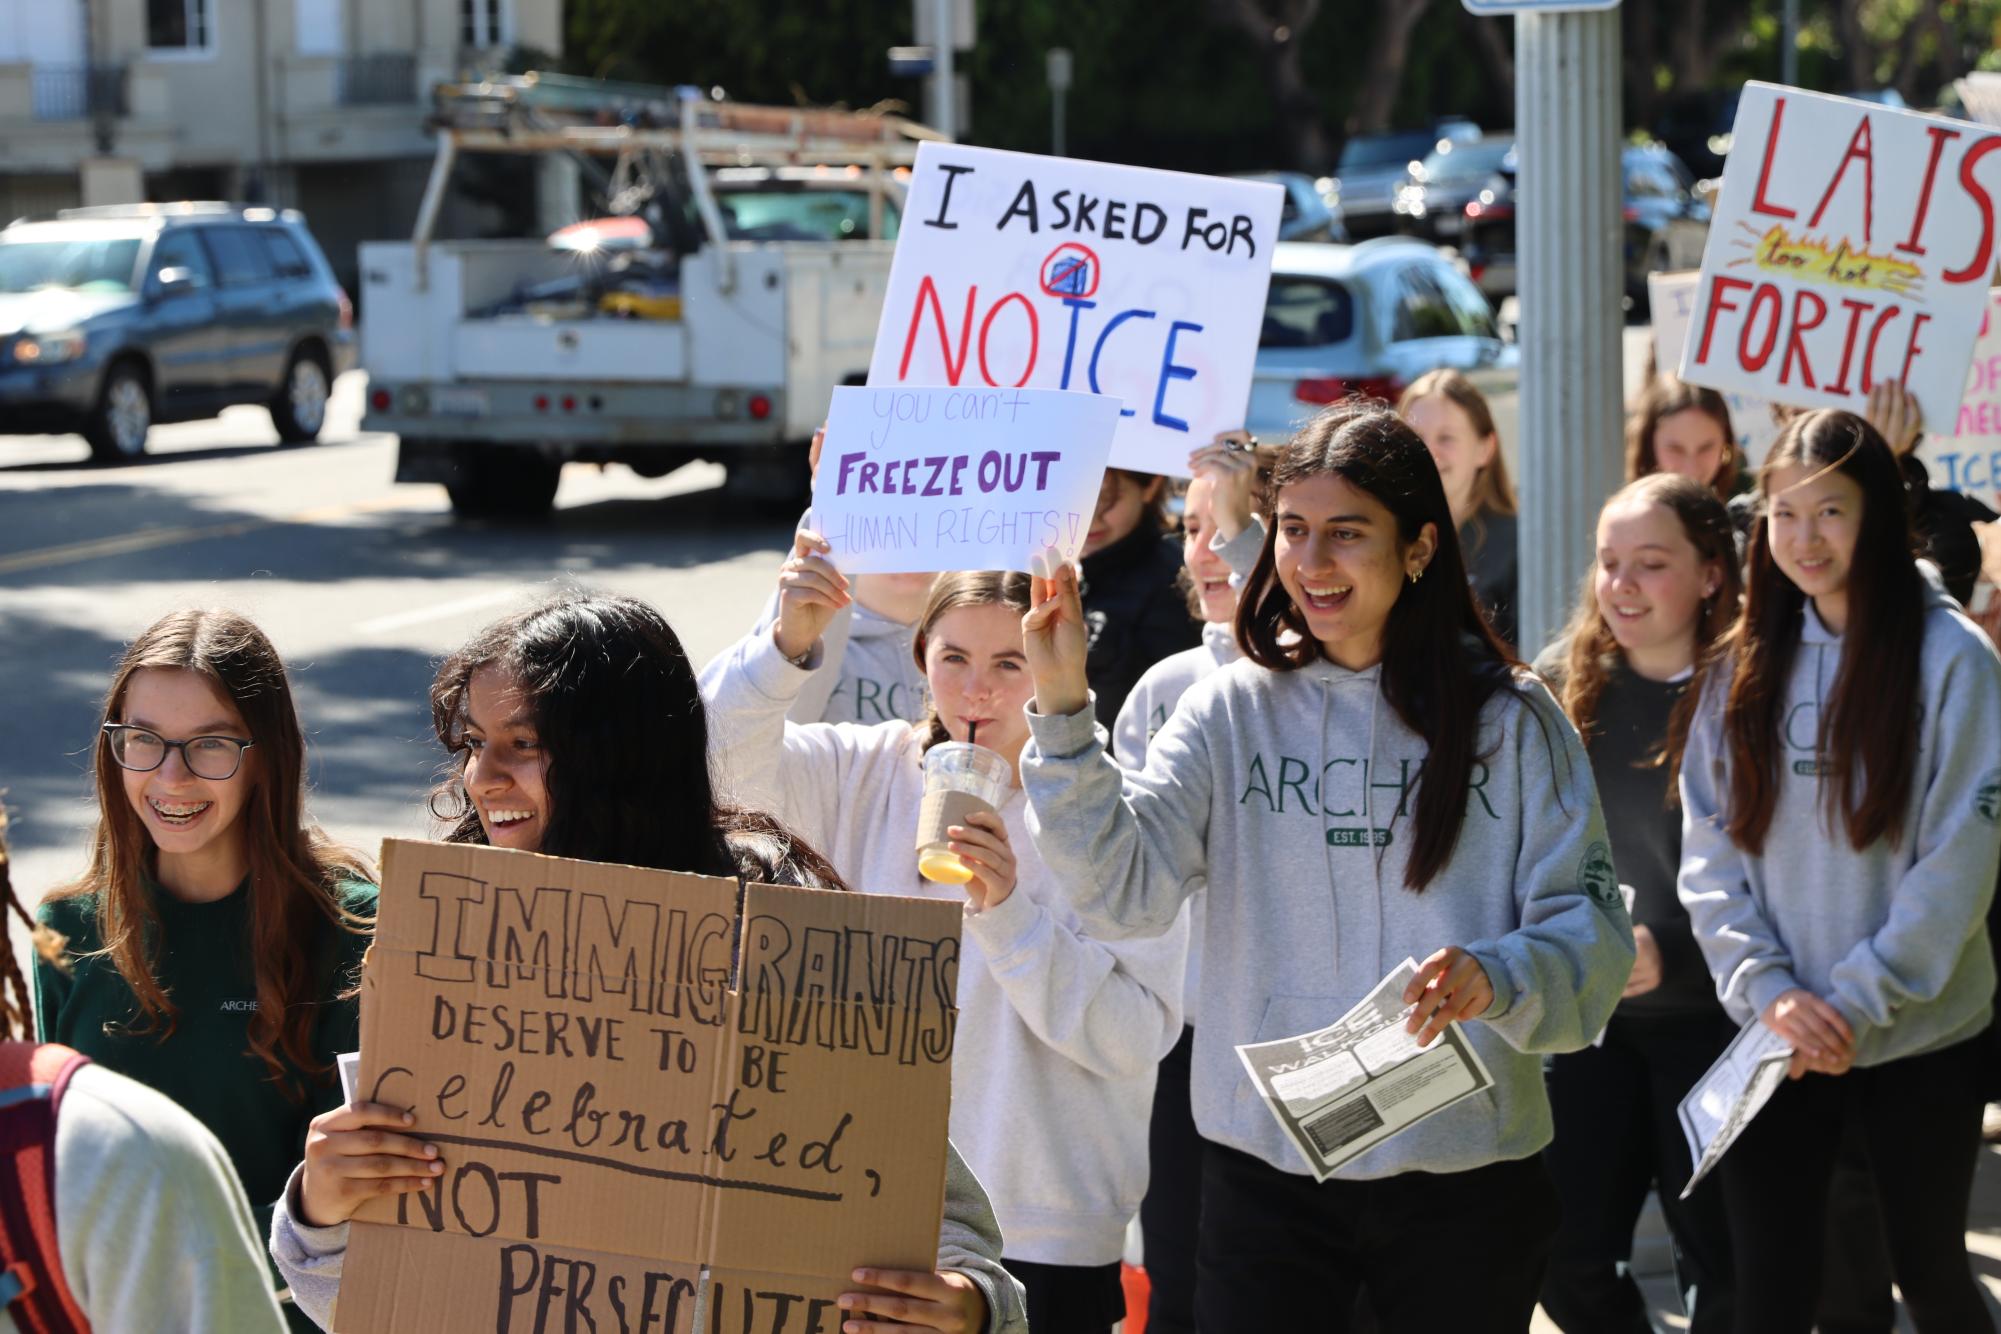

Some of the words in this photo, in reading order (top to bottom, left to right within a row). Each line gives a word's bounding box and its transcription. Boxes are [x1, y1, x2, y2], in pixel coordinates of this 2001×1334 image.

[924, 164, 974, 229] I
[997, 180, 1168, 244] ASKED
[1181, 207, 1256, 259] FOR
[1751, 97, 1874, 243] LA
[1894, 126, 2001, 284] IS
[1766, 237, 1805, 267] too
[1827, 244, 1870, 283] hot
[1695, 275, 1827, 389] FOR
[944, 389, 1031, 424] can't
[836, 451, 969, 497] FREEZE
[977, 449, 1072, 494] OUT
[820, 511, 918, 556] HUMAN
[935, 506, 1081, 557] RIGHTS!
[1239, 752, 1502, 820] ARCHR
[1333, 831, 1356, 844] EST.
[415, 872, 959, 1065] IMMIGRANTS
[432, 995, 625, 1062] DESERVE
[650, 1028, 697, 1074] TO
[741, 1045, 789, 1093] BE
[1298, 1001, 1383, 1053] ICE
[398, 1161, 561, 1239] NOT
